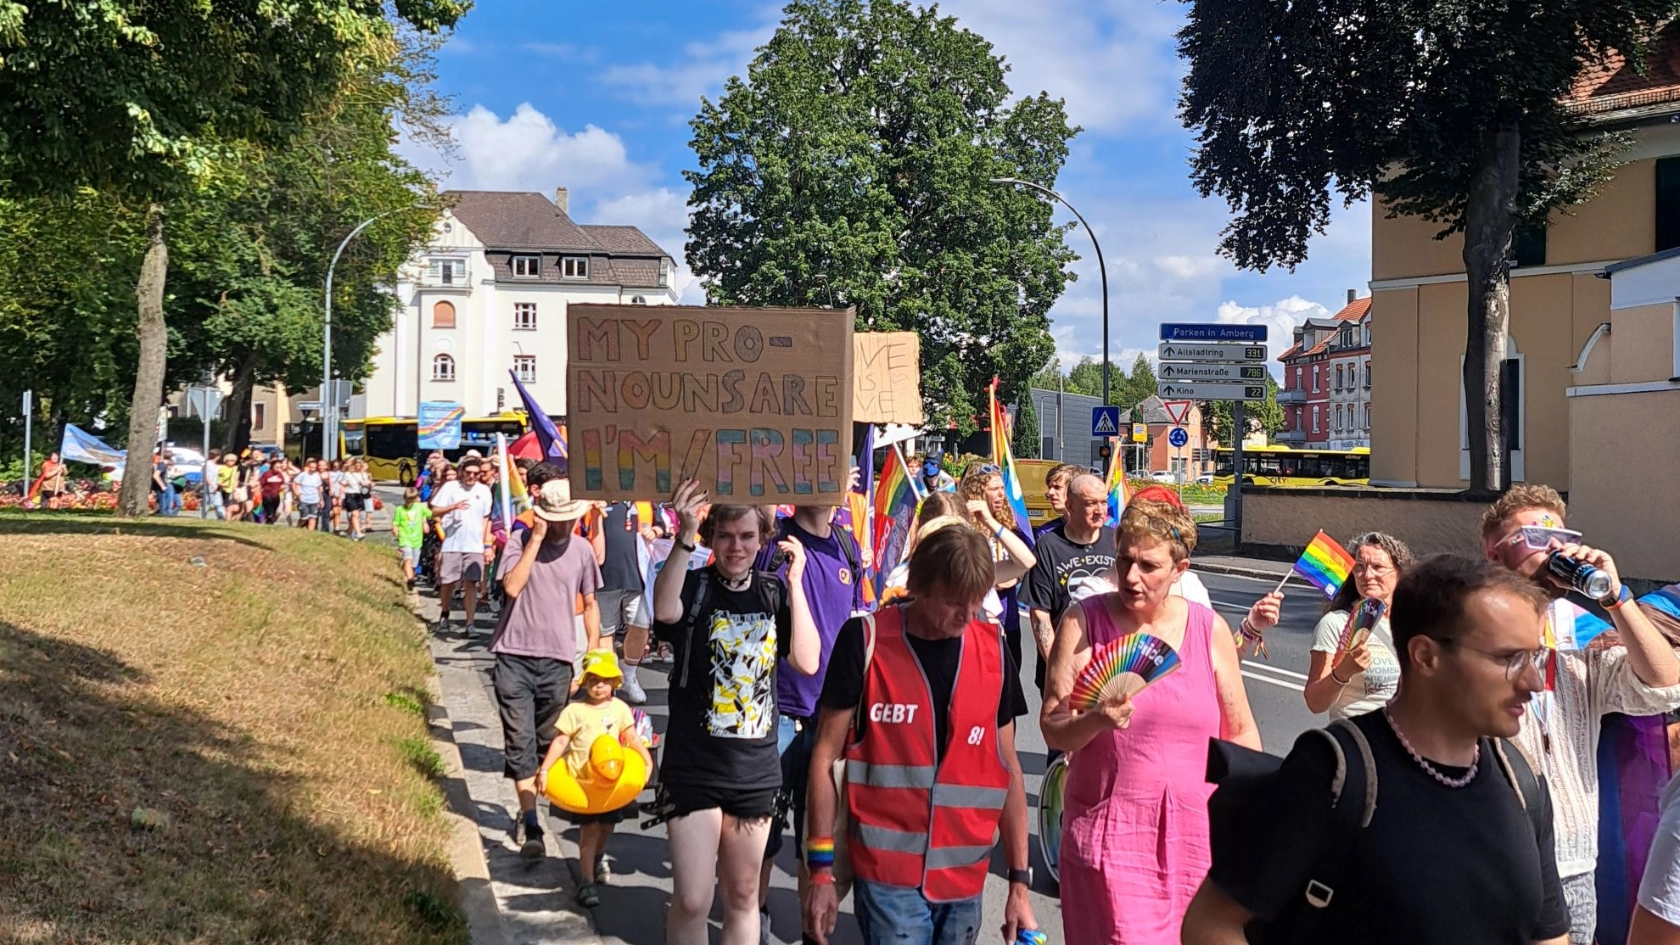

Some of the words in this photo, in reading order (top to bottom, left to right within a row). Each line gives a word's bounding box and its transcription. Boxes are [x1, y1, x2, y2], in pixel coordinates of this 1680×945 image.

[1173, 327, 1205, 337] Parken
[1207, 327, 1216, 337] in
[1219, 328, 1255, 339] Amberg
[577, 316, 662, 361] MY
[673, 319, 793, 363] PRO-
[856, 342, 909, 371] VE
[1177, 348, 1224, 358] Altstadtring
[1246, 349, 1262, 358] 331
[1176, 367, 1229, 377] Marienstraße
[1246, 368, 1262, 377] 786
[1176, 387, 1195, 395] Kino
[1251, 388, 1262, 397] 22
[855, 391, 898, 414] VE
[1061, 557, 1082, 571] WE
[1085, 554, 1116, 567] EXIST
[869, 702, 919, 724] GEBT
[967, 725, 986, 746] 8!
